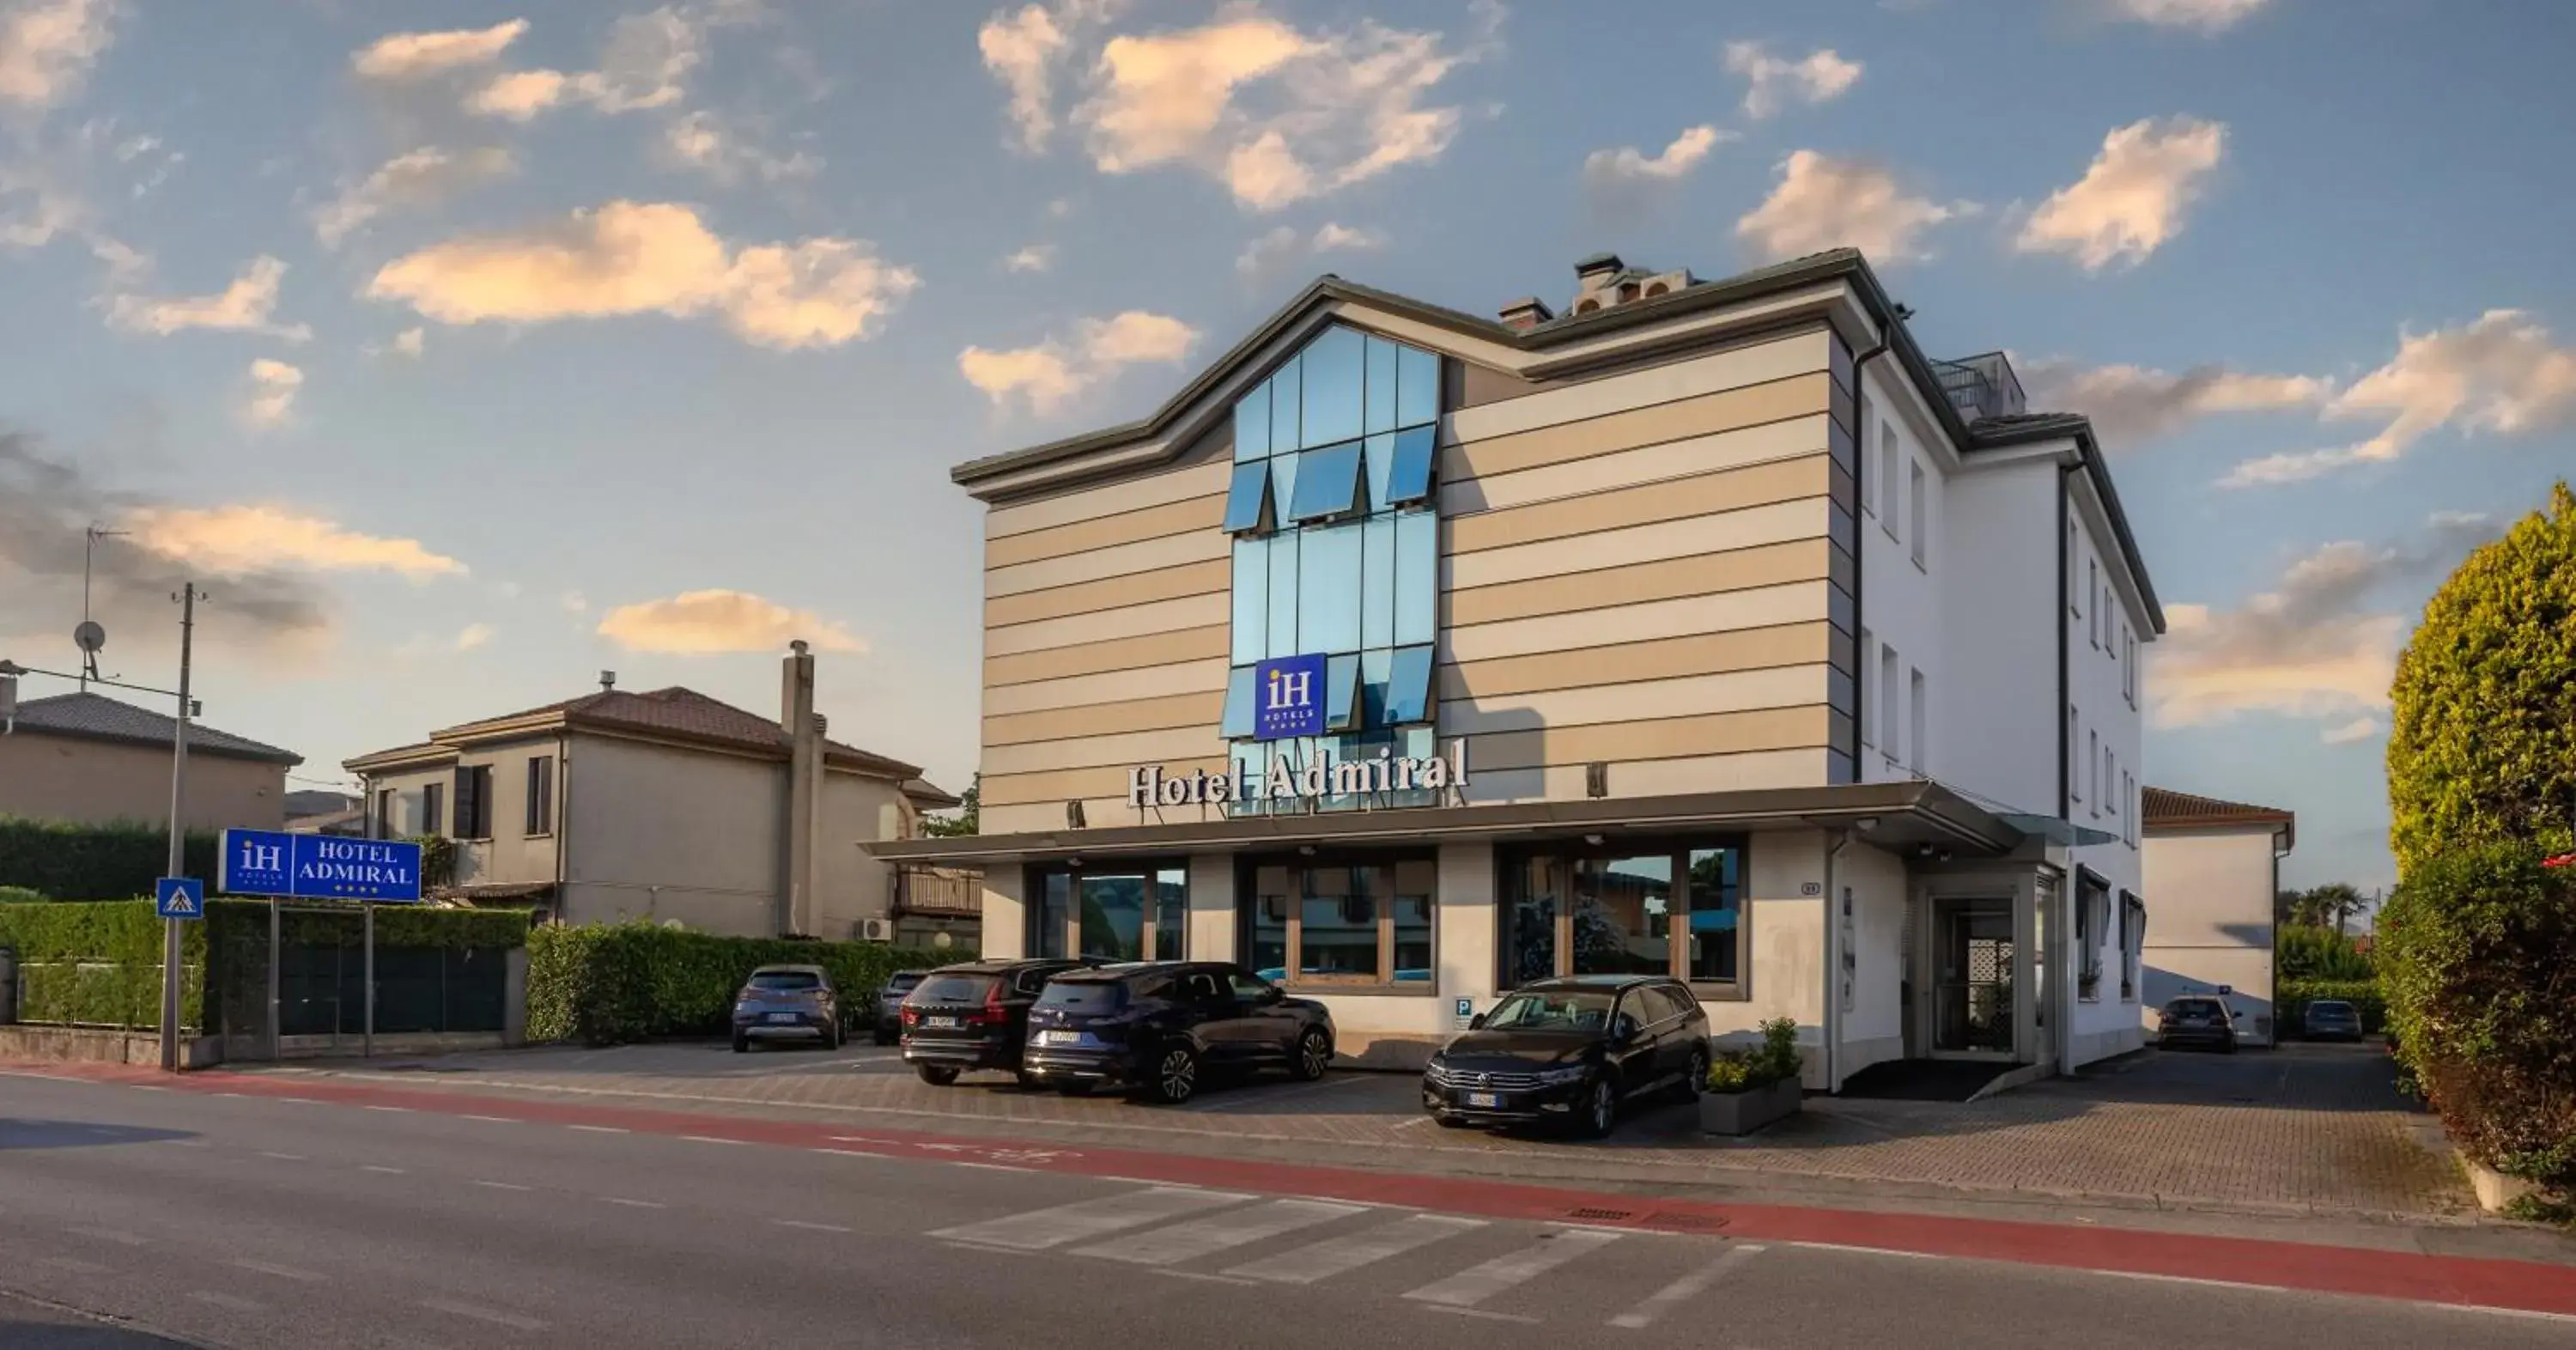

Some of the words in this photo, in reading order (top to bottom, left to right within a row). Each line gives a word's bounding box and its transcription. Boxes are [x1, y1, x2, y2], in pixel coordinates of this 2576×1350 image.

[1127, 757, 1243, 808] Hotel
[1262, 738, 1468, 799] Admiral
[319, 841, 398, 863] HOTEL
[299, 861, 413, 884] ADMIRAL
